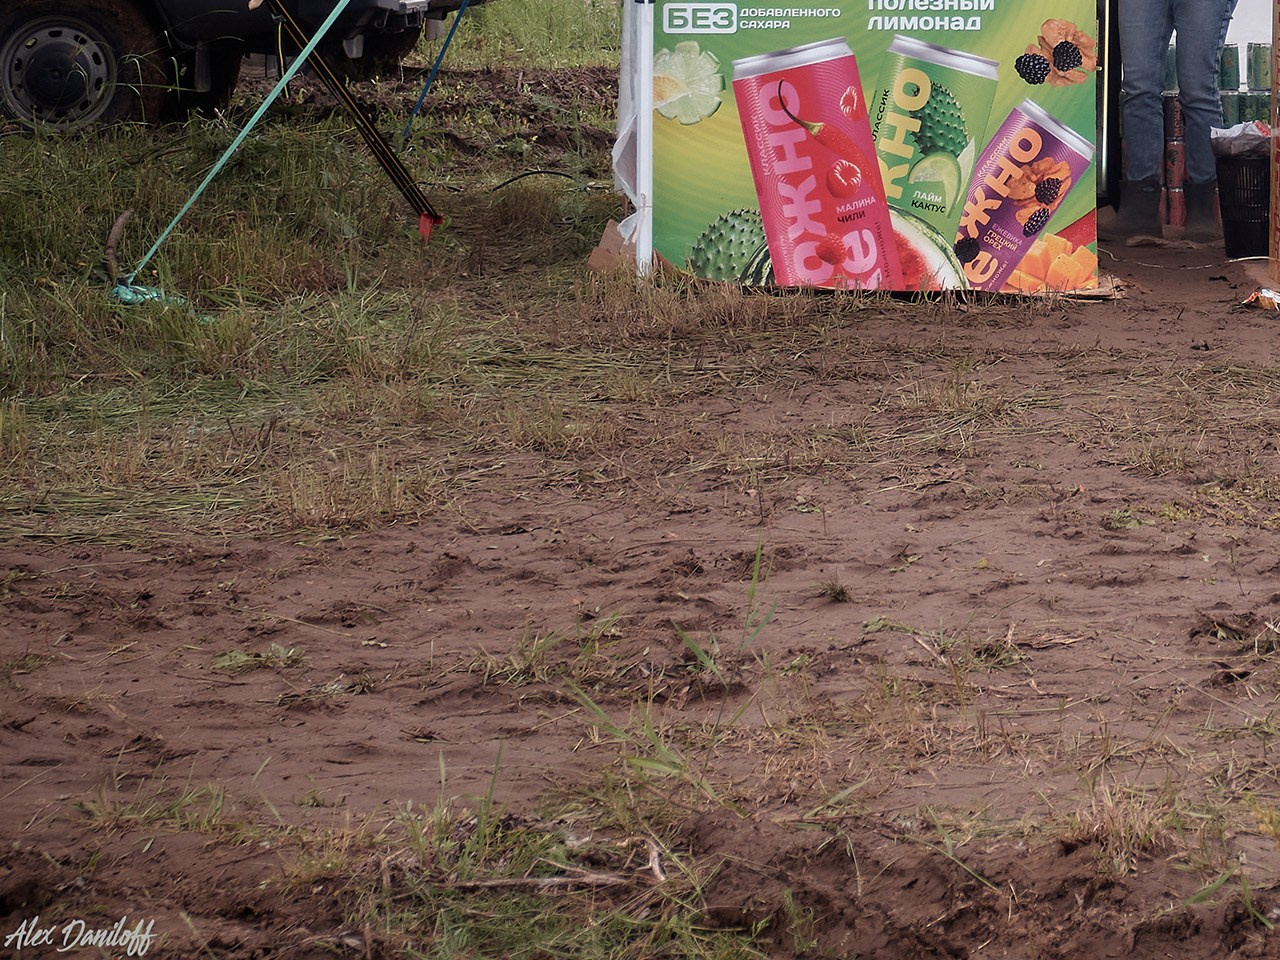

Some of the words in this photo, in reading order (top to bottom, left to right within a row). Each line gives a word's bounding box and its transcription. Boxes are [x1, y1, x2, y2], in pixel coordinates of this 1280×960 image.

[668, 8, 734, 29] БЕЗ
[740, 8, 841, 18] ДОБАВЛЕННОГО
[740, 21, 791, 29] САХАРА
[868, 16, 982, 31] лимонад
[912, 190, 943, 203] ЛАЙМ
[836, 196, 876, 213] МАЛИНА
[911, 200, 946, 214] КАКТУС
[837, 211, 866, 224] ЧИЛИ
[987, 230, 1018, 252] ГРЕЦКИЙ
[992, 223, 1023, 245] ЕЖЕВИКА
[983, 236, 1002, 251] ОРЕХ
